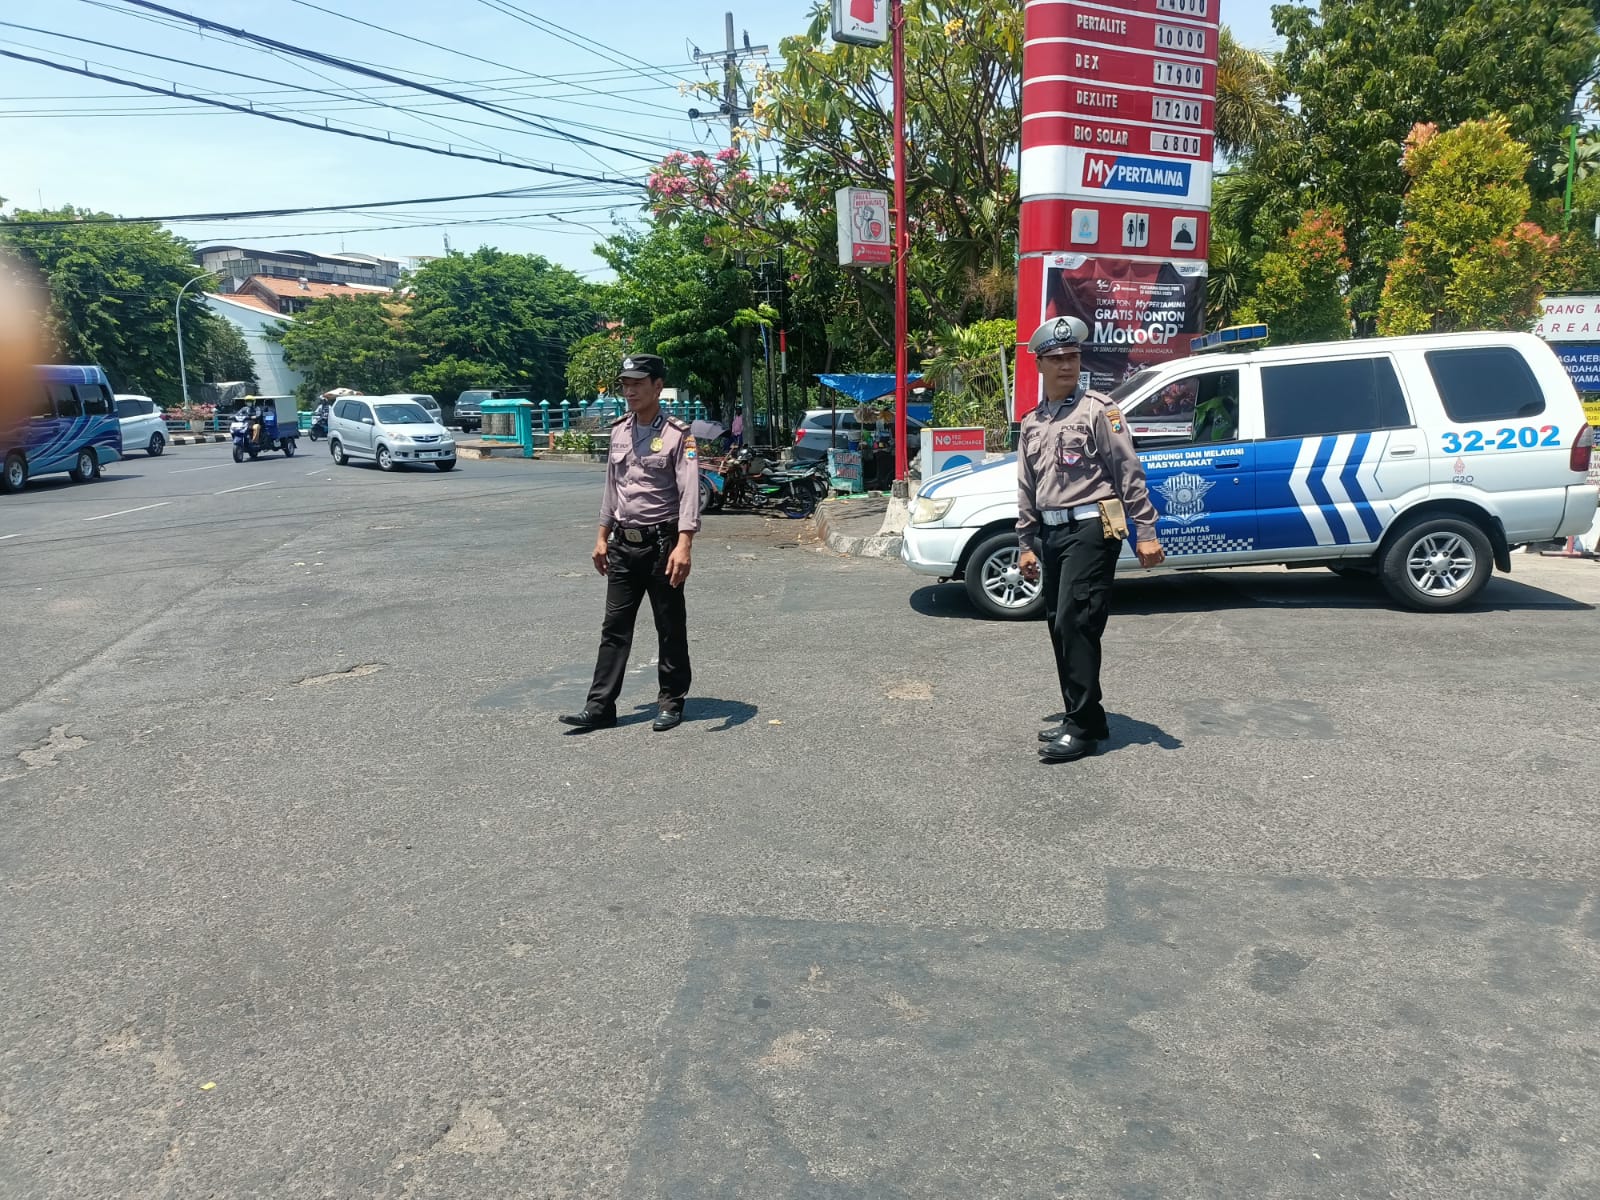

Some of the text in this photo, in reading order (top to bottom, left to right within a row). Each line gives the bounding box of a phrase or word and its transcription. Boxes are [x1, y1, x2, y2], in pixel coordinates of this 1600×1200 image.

[1077, 14, 1127, 34] PERTALITE
[1158, 28, 1203, 48] 10000
[1075, 53, 1099, 70] DEX
[1156, 64, 1201, 85] 17900
[1076, 90, 1118, 108] DEXLITE
[1155, 101, 1199, 122] 17200
[1074, 125, 1129, 146] BIO SOLAR
[1162, 135, 1198, 154] 6800
[1095, 308, 1185, 322] GRATIS NONTON
[1093, 321, 1179, 345] MotoGP
[1570, 375, 1600, 383] YAMA
[935, 435, 951, 446] NO
[1441, 425, 1561, 454] 32-202
[1137, 448, 1244, 462] ELINDUNGI DAN MELAYANI
[1147, 458, 1213, 469] MASYARAKAT
[1160, 525, 1210, 536] UNIT LANTAS
[1197, 533, 1226, 542] CANTIAN
